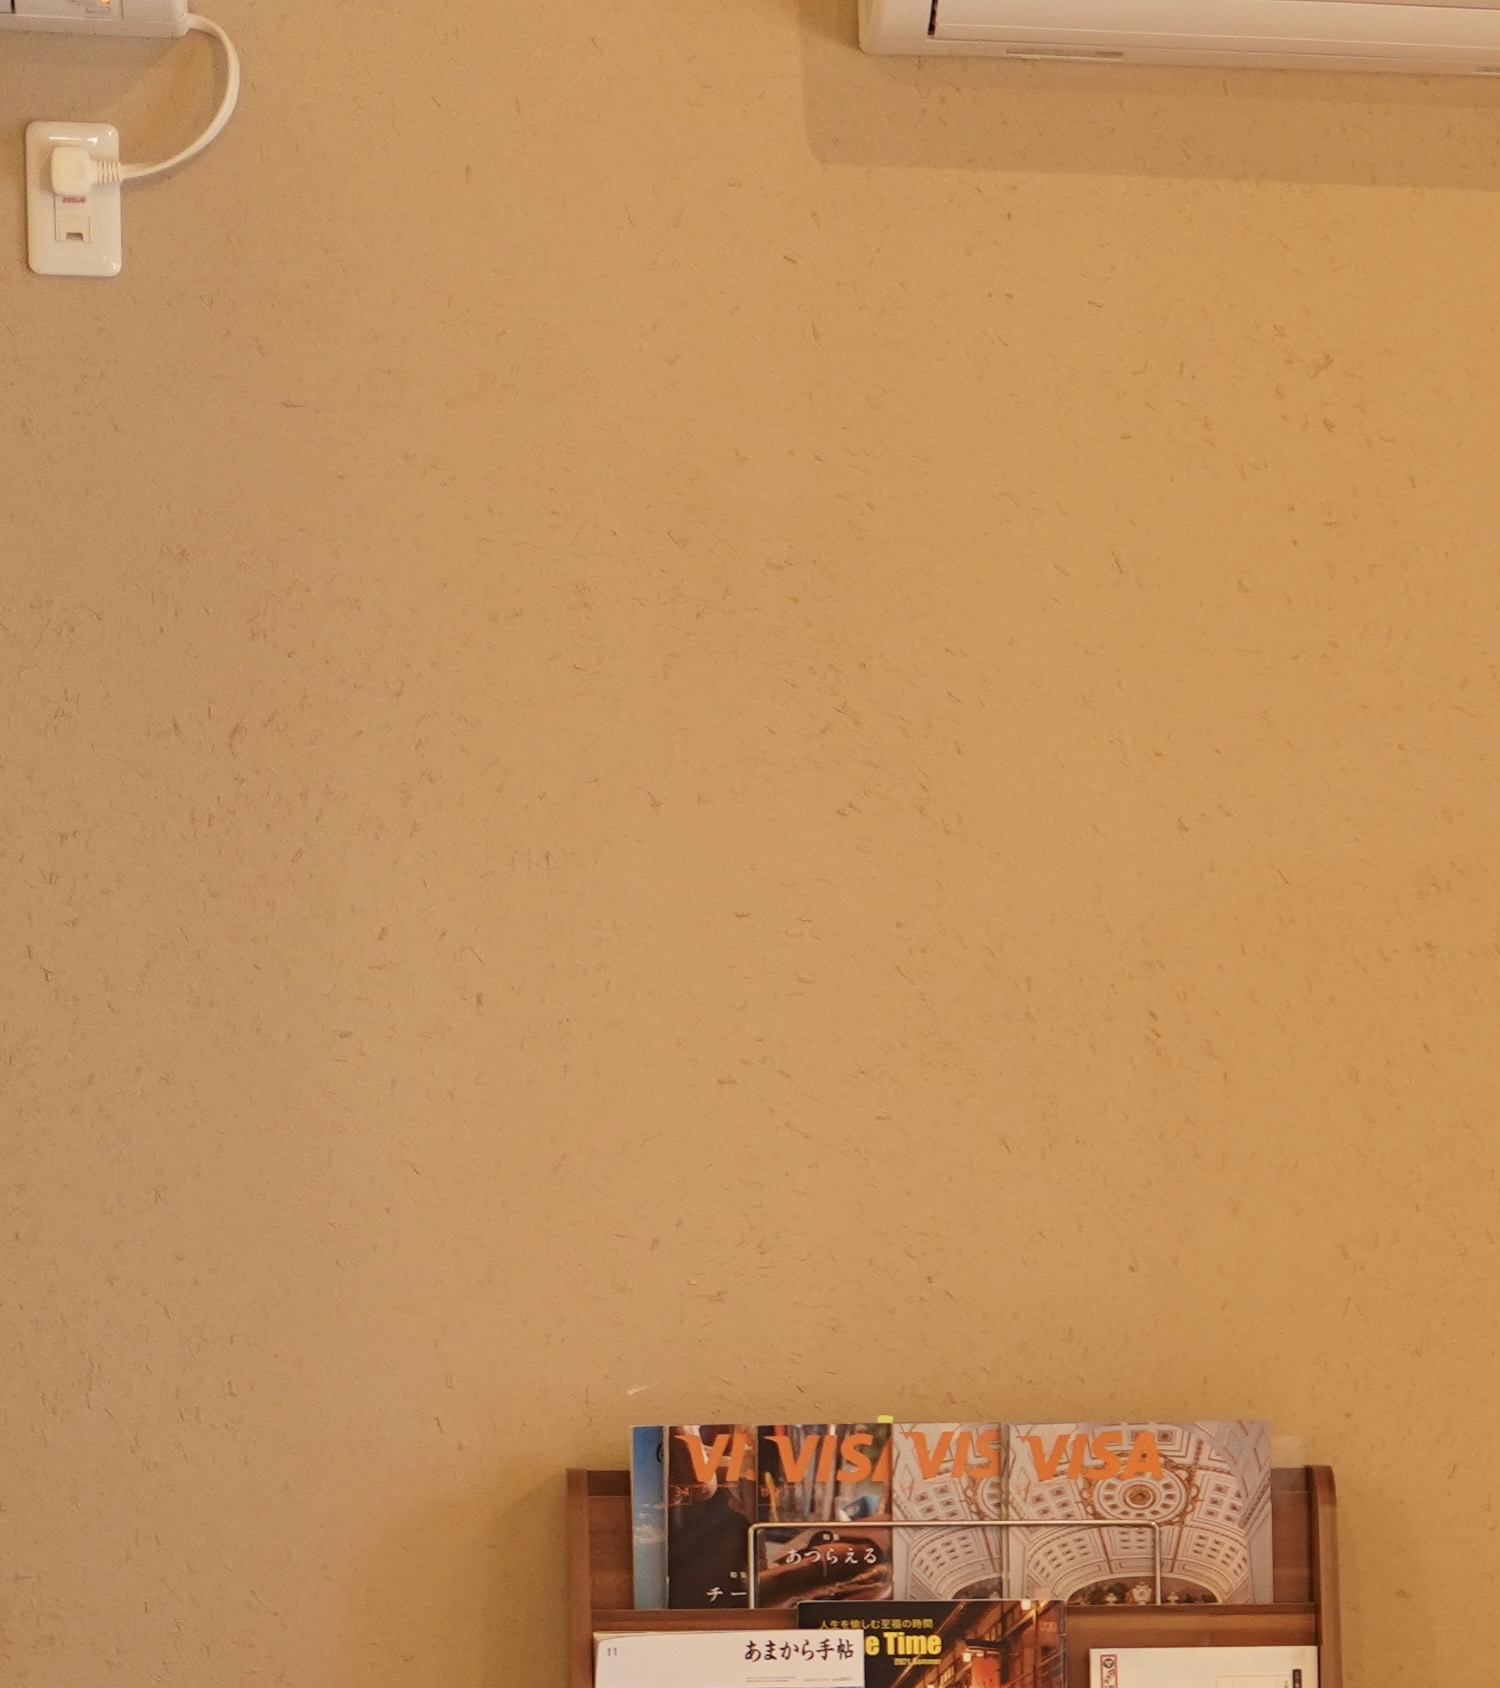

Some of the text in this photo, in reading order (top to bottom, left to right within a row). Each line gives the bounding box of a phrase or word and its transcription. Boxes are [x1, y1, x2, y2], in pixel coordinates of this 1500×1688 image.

[674, 1434, 756, 1484] VI
[1017, 1431, 1163, 1482] VISA
[785, 1549, 877, 1564] あつらえる
[744, 1638, 854, 1663] あまから手帖
[883, 1631, 942, 1656] Time
